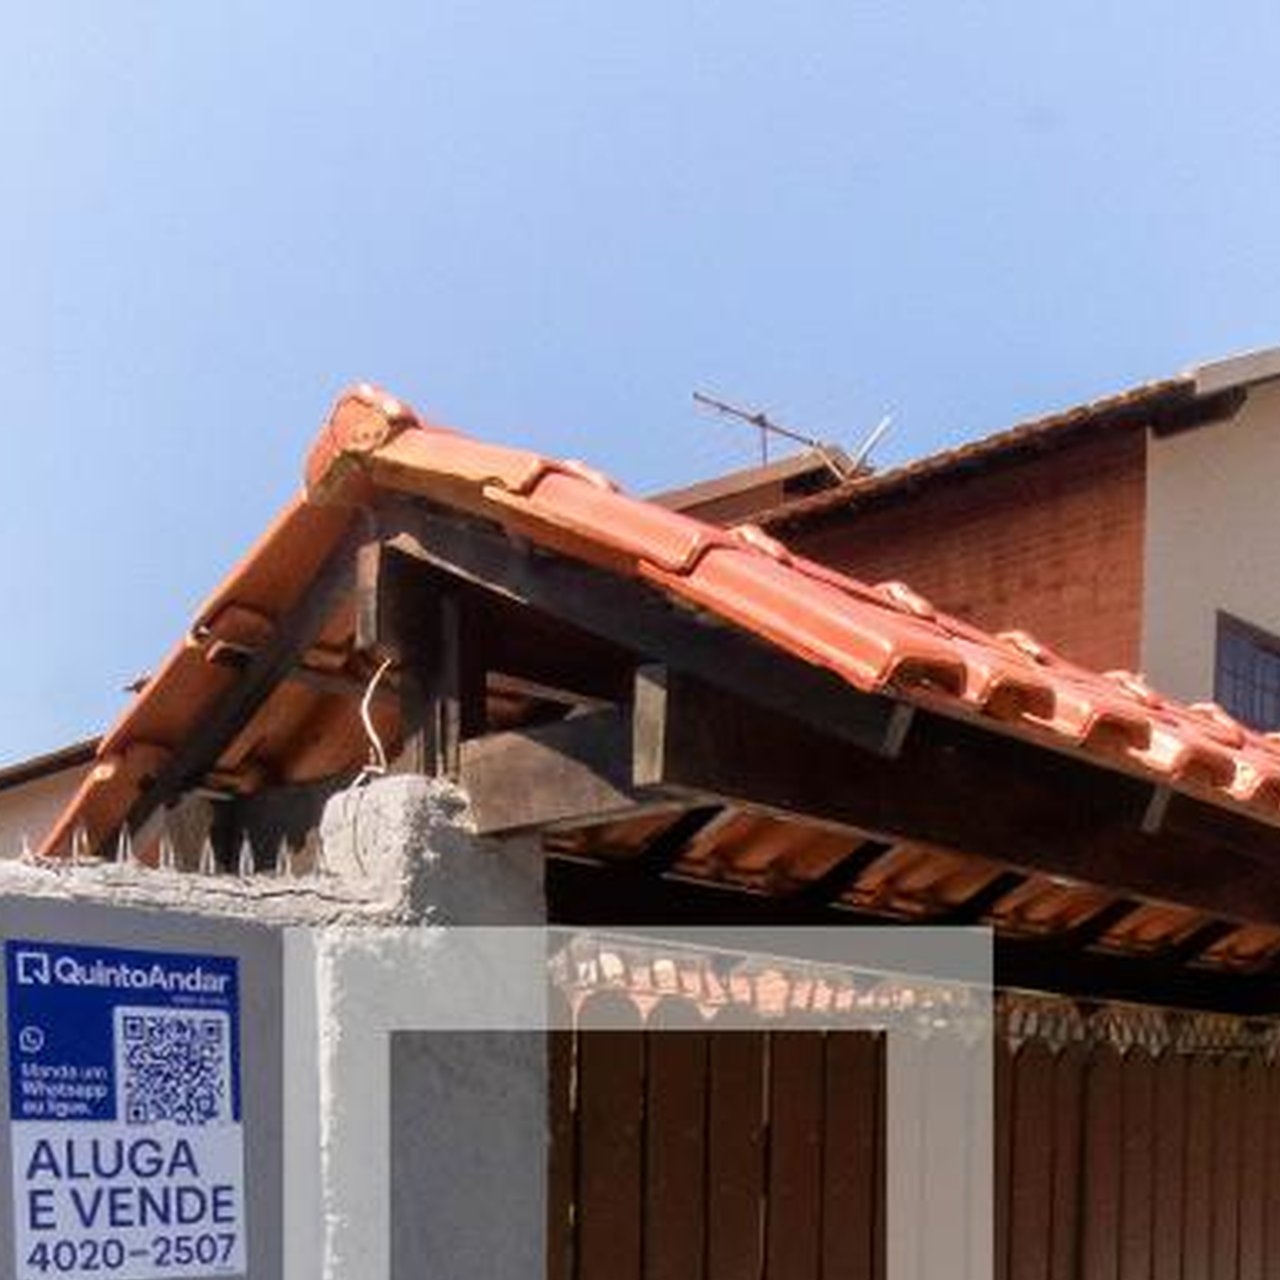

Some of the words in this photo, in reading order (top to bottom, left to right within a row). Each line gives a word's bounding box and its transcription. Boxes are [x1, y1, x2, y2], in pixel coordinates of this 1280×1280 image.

[54, 957, 230, 993] QuintoAndar
[26, 1138, 199, 1180] ALUGA
[28, 1188, 57, 1230] E
[71, 1185, 236, 1229] VENDE
[26, 1232, 236, 1272] 4020-2507
